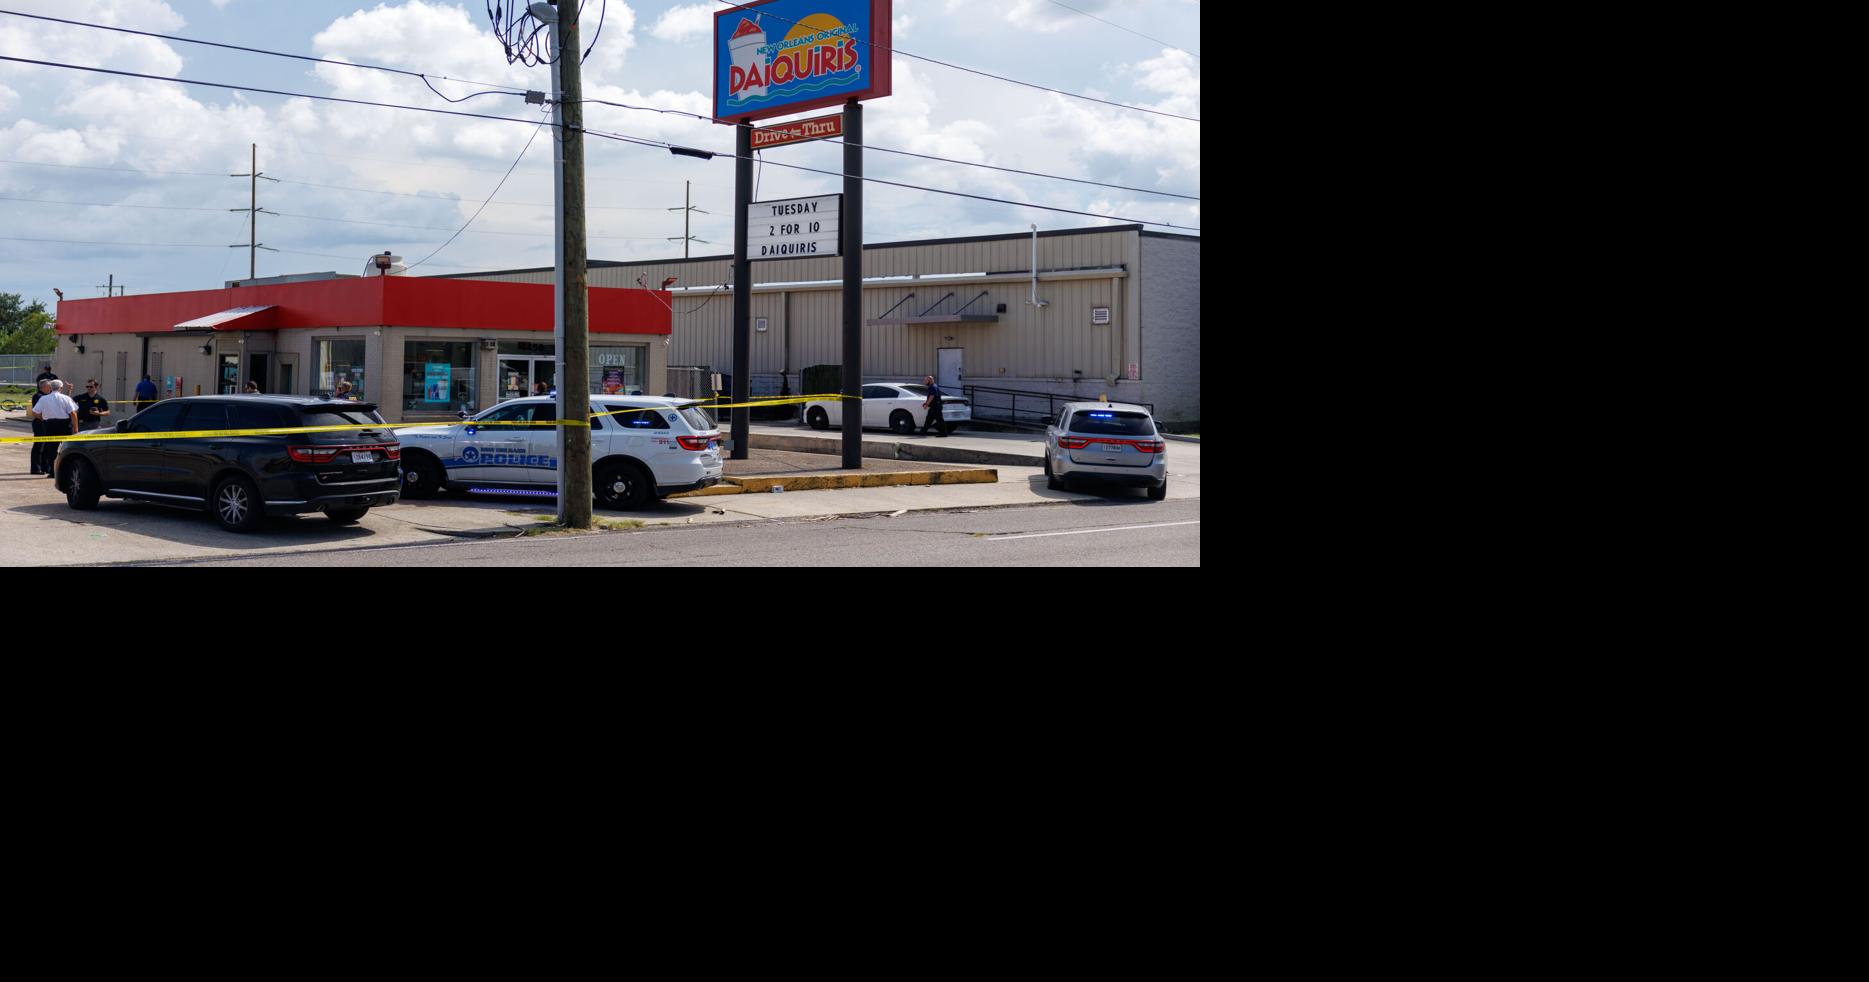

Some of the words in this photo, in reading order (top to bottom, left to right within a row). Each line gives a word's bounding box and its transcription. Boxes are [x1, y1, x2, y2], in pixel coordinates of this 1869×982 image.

[757, 44, 776, 55] NEW
[776, 35, 814, 51] ORLEANS
[818, 23, 859, 41] ORIGINAL
[755, 130, 788, 144] Drive
[802, 121, 835, 135] Thru
[772, 202, 818, 216] TUESDAY
[770, 226, 775, 236] 2
[781, 223, 800, 235] FOR
[809, 222, 820, 232] 10
[762, 242, 817, 255] DAIQUIRIS
[599, 354, 625, 366] OPEN
[480, 453, 549, 465] POLICE
